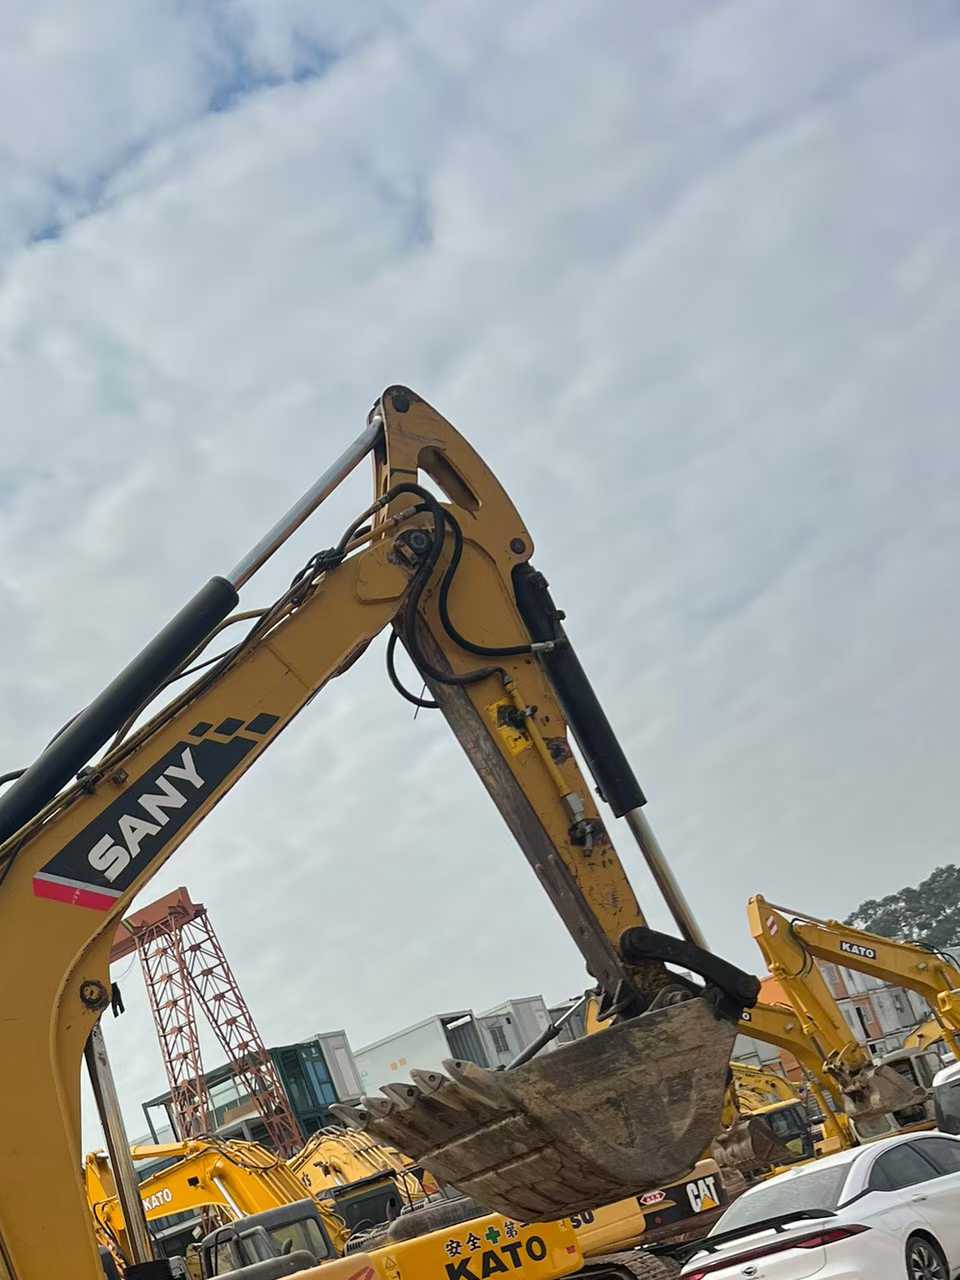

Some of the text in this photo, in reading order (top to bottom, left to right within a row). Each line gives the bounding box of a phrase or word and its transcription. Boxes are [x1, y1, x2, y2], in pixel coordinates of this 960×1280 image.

[87, 746, 206, 884] SANY
[841, 942, 875, 958] KATO
[142, 1188, 173, 1212] KATO
[686, 1175, 721, 1214] CAT
[445, 1231, 482, 1258] 安全
